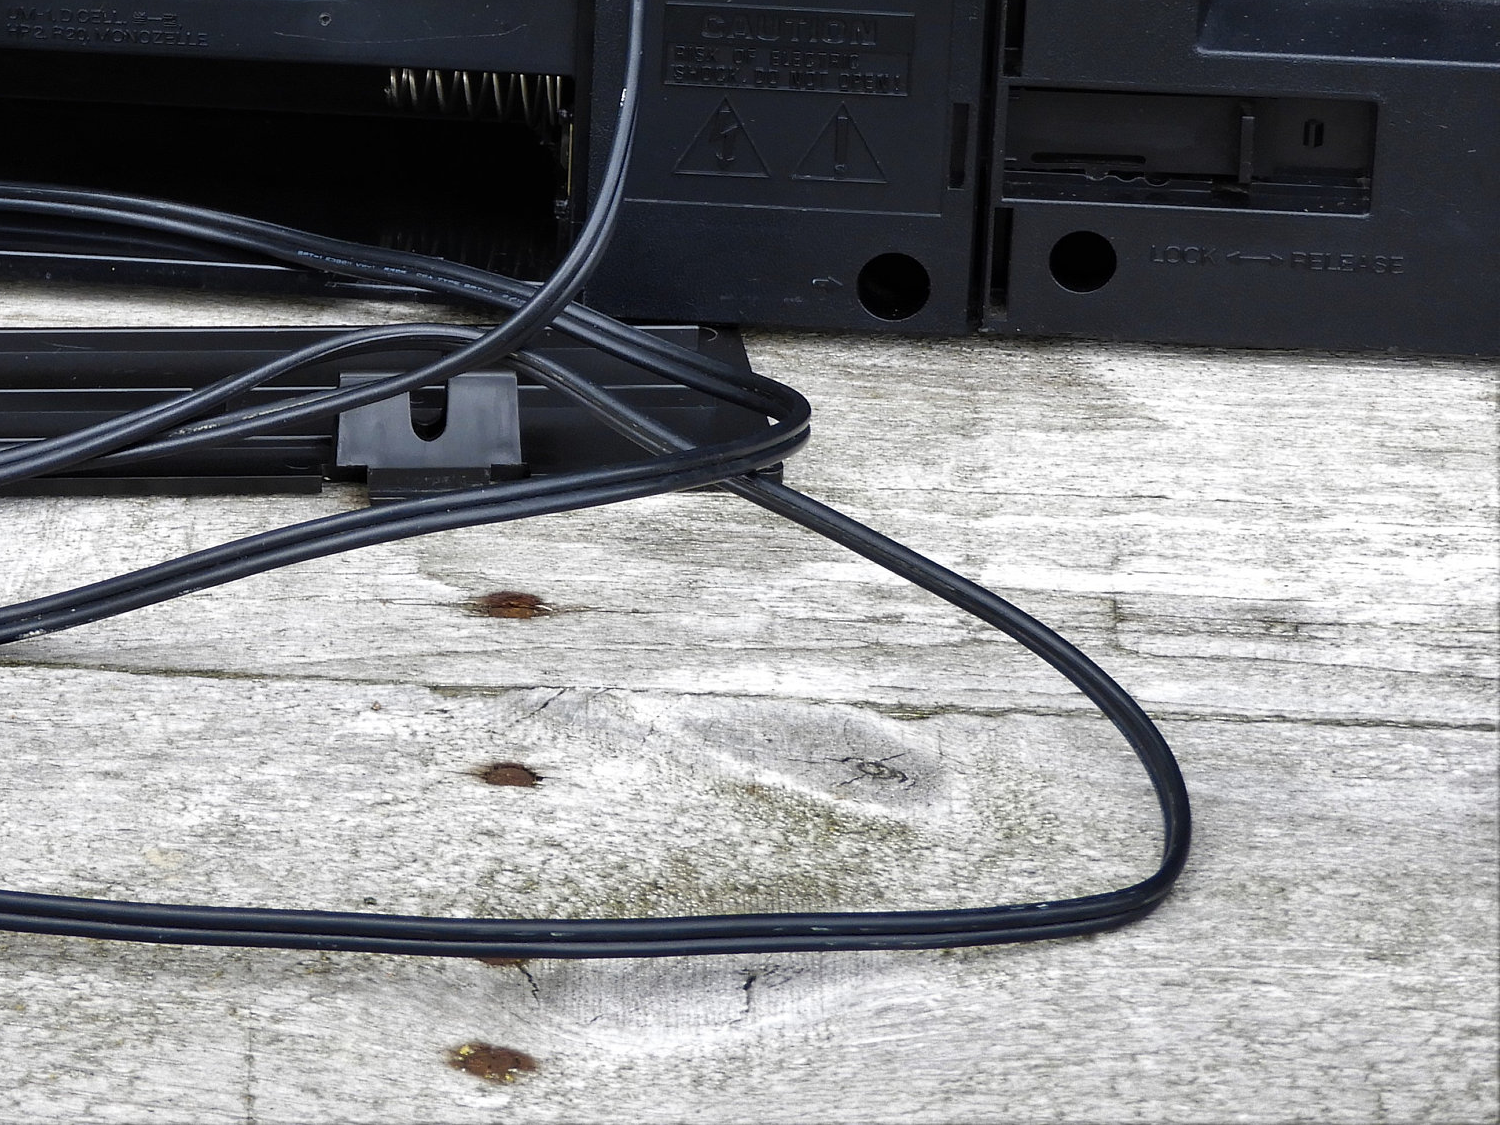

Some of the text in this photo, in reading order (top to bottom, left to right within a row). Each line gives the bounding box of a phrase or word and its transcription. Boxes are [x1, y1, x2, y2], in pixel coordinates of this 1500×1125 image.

[699, 15, 877, 46] CAUTION
[1150, 243, 1406, 275] LOCK RELEASE
